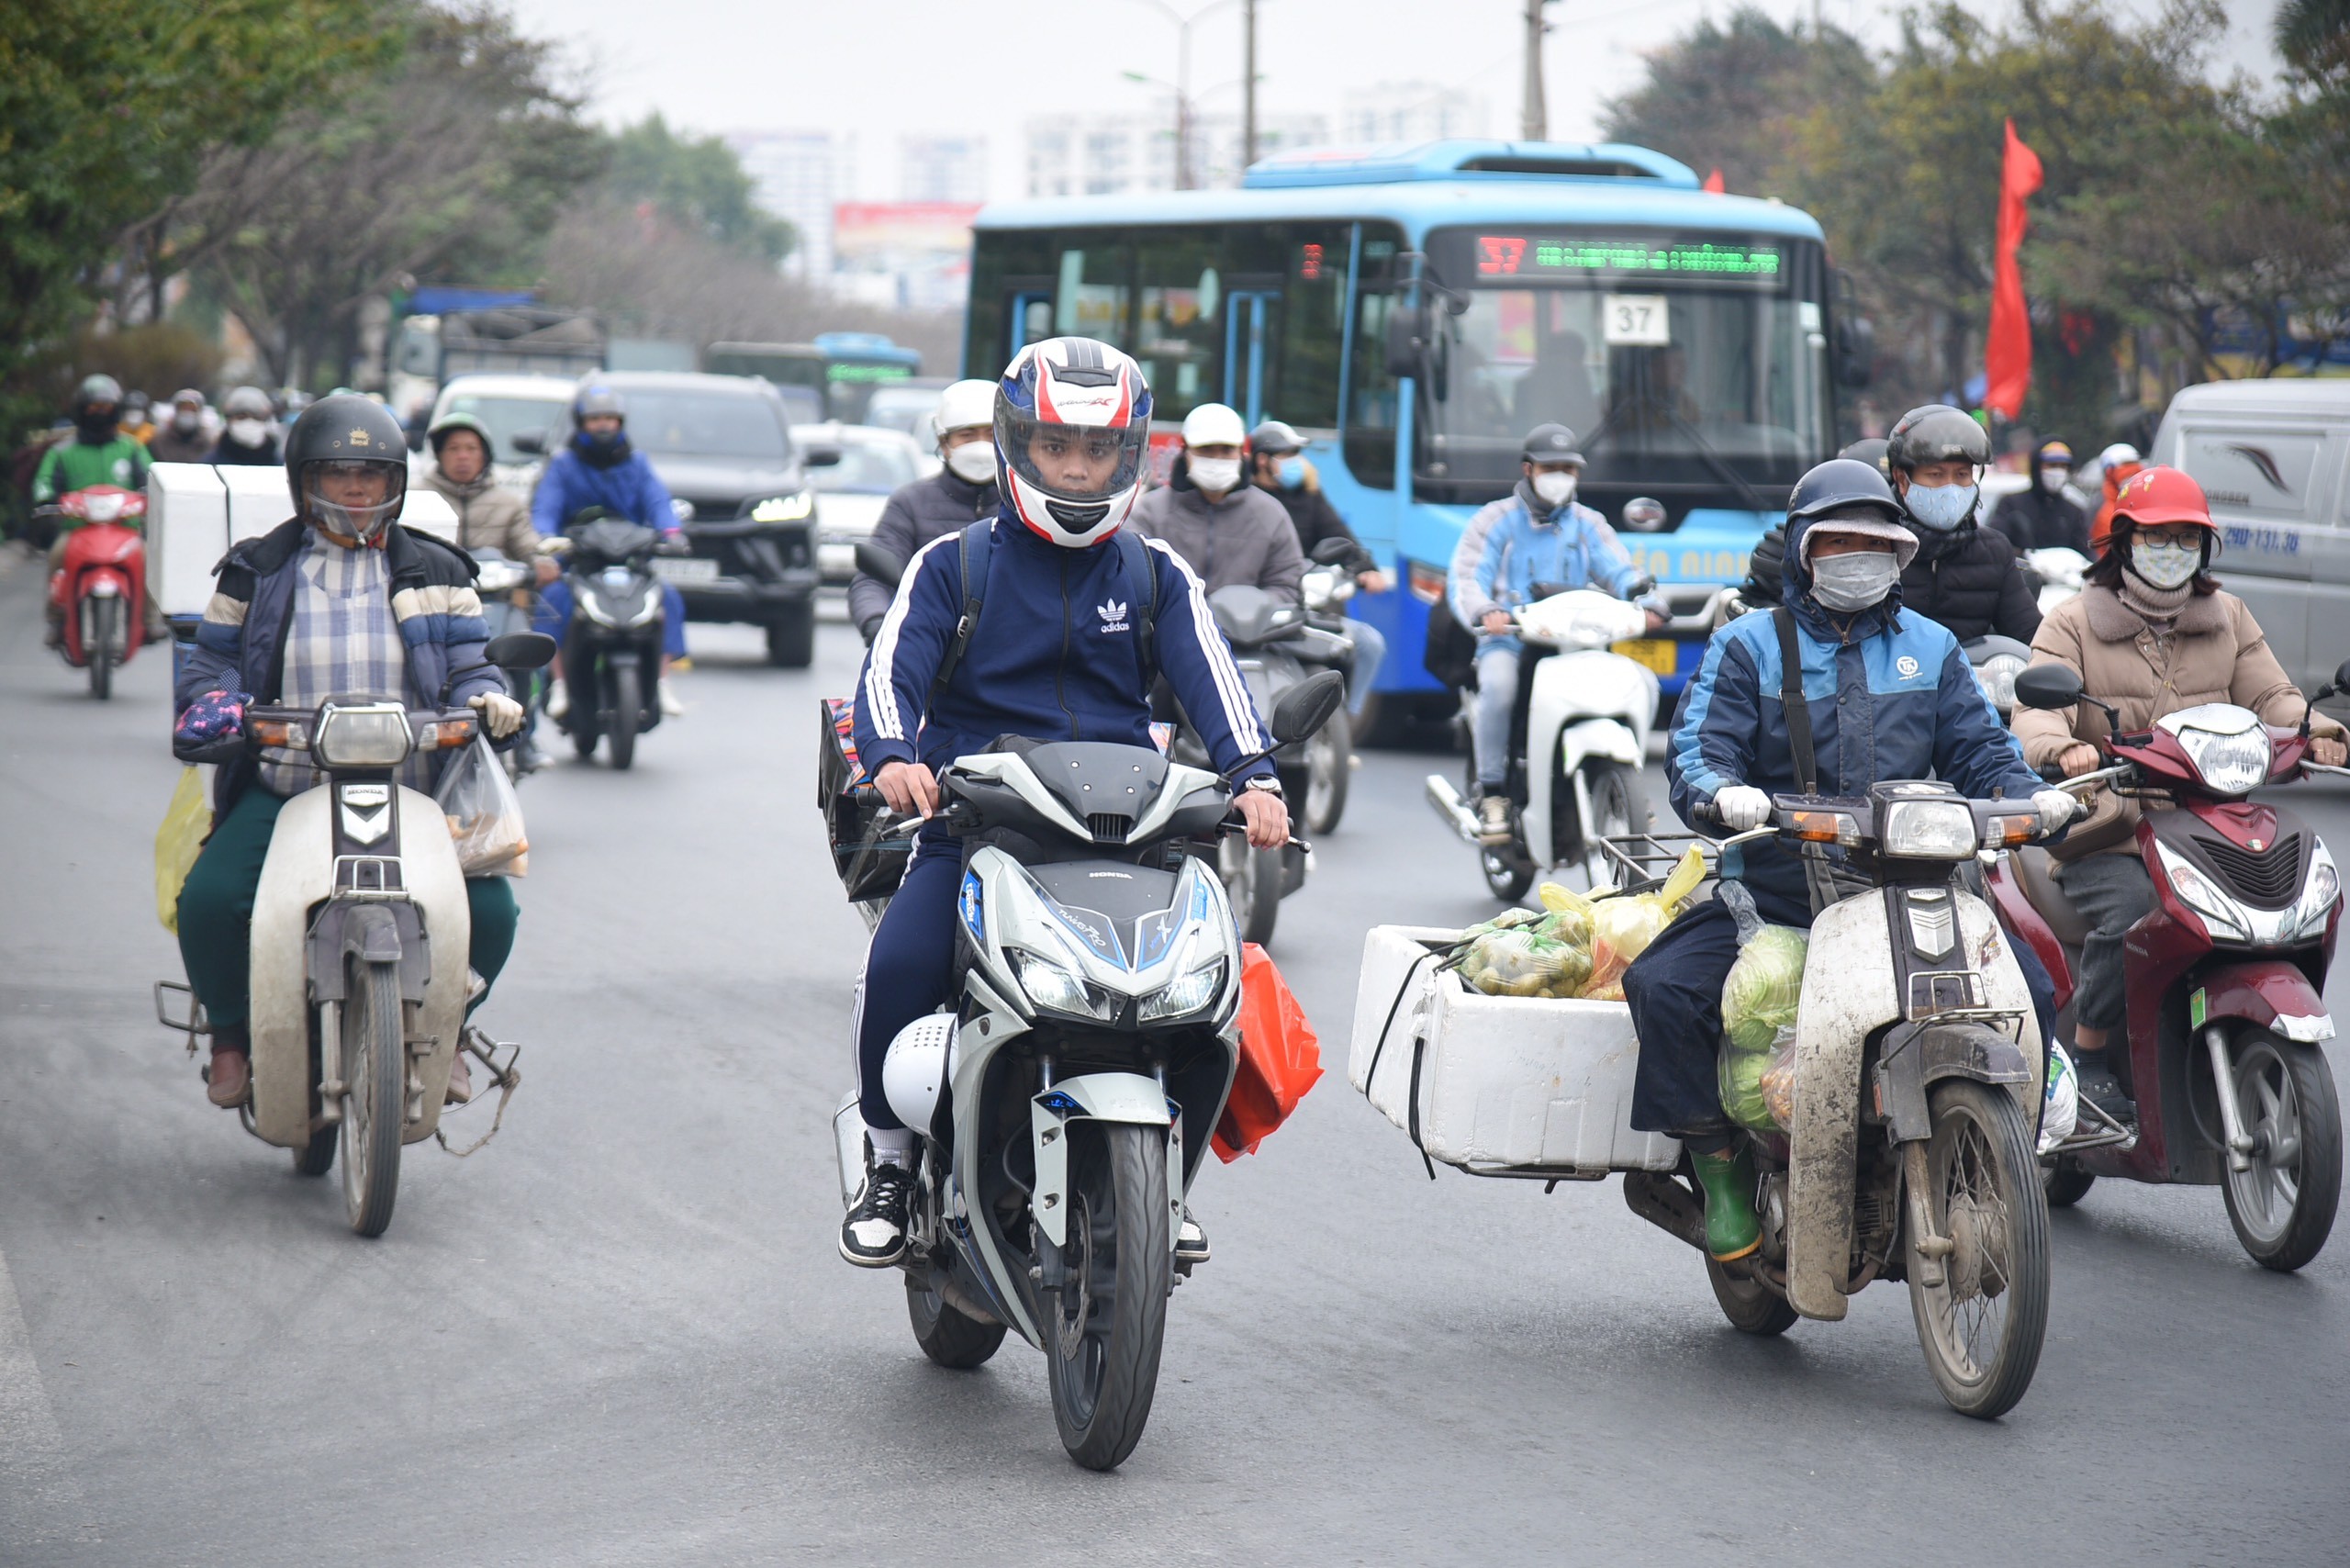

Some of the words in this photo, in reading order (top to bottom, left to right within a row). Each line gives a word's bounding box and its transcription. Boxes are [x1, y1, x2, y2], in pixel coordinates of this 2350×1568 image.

[1617, 304, 1652, 332] 37
[1101, 622, 1130, 633] adidas
[1089, 871, 1134, 879] HONDA
[2125, 941, 2149, 958] HONDA
